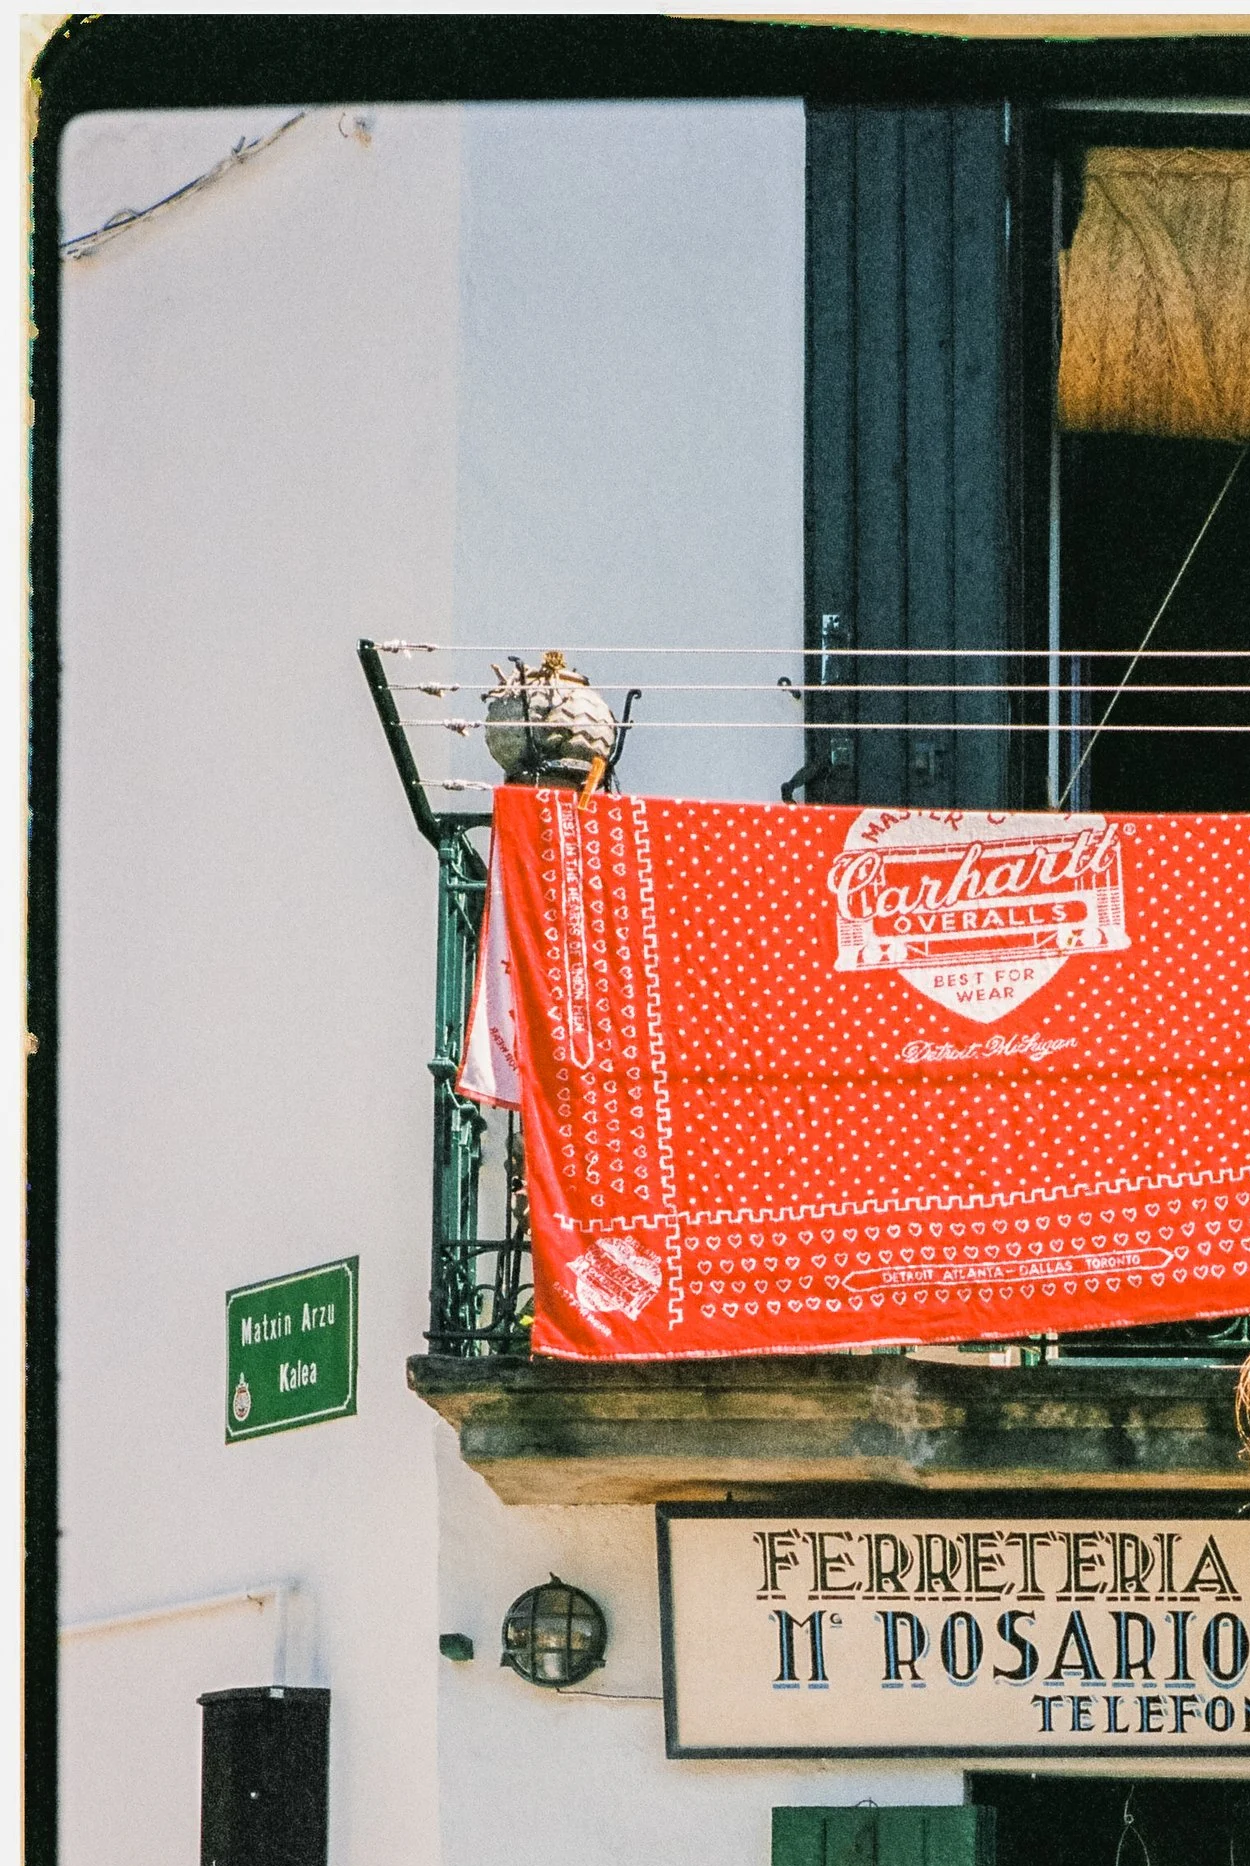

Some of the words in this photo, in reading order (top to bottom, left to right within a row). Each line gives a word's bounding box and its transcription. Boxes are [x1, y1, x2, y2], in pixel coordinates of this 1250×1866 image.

[827, 822, 1120, 921] Carhartt
[893, 904, 1067, 934] OVERALLS
[933, 972, 984, 989] BEST
[995, 968, 1035, 984] FOR
[956, 986, 1015, 1004] WEAR
[882, 1268, 933, 1284] DETROIT
[943, 1264, 1004, 1281] ATLANTA
[1019, 1259, 1073, 1276] DALLAS
[1085, 1253, 1141, 1269] TORONTO
[241, 1311, 292, 1347] Matxin
[301, 1302, 336, 1333] Arzu
[279, 1359, 318, 1393] Kalea
[753, 1529, 1243, 1601] FERRETERIA
[874, 1610, 1250, 1689] ROSARIO
